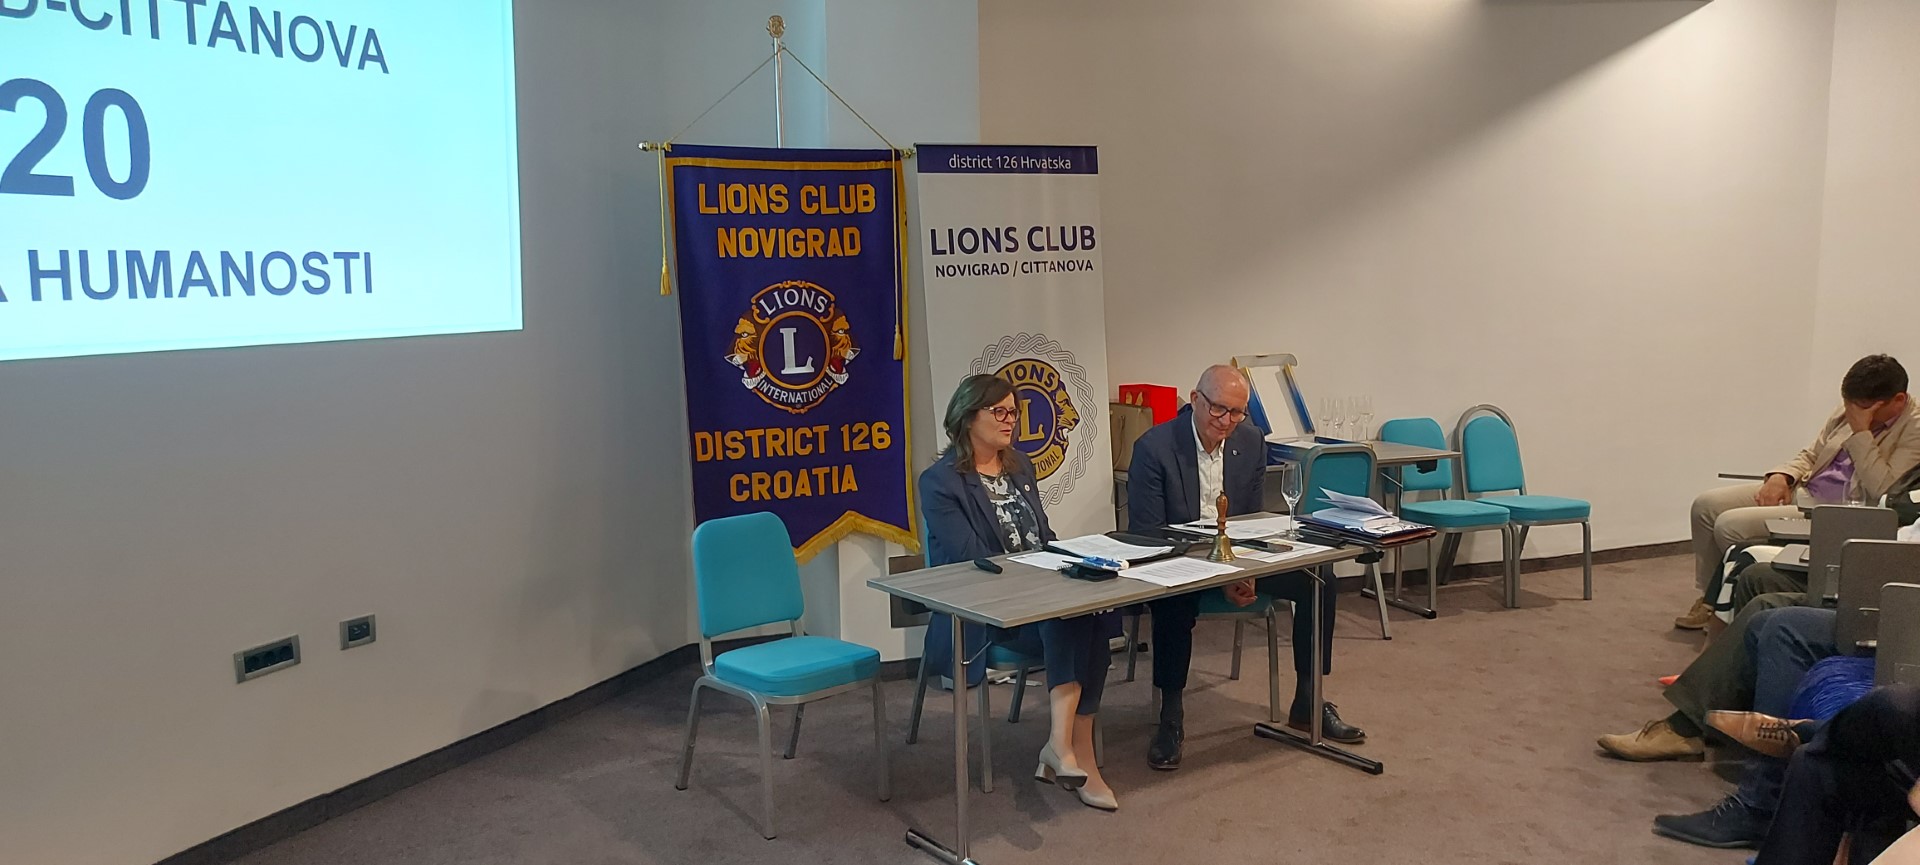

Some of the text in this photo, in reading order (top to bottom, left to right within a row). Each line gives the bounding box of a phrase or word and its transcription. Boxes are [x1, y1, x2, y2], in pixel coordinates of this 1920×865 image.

[0, 78, 151, 200] 20
[949, 154, 1072, 170] district 126 Hrvatska
[698, 183, 877, 215] LIONS CLUB
[717, 226, 862, 258] NOVIGRAD
[930, 225, 1097, 256] LIONS CLUB
[28, 249, 373, 301] HUMANOSTI
[935, 262, 1010, 278] NOVIGRAD
[1020, 259, 1094, 274] CITTANOVA
[758, 288, 829, 316] LIONS
[779, 327, 815, 375] L
[758, 377, 833, 404] INTERNATIONAL
[1005, 364, 1055, 387] IONS
[1018, 398, 1045, 442] L
[694, 421, 892, 463] DISTRICT 126
[729, 464, 859, 503] CROATIA
